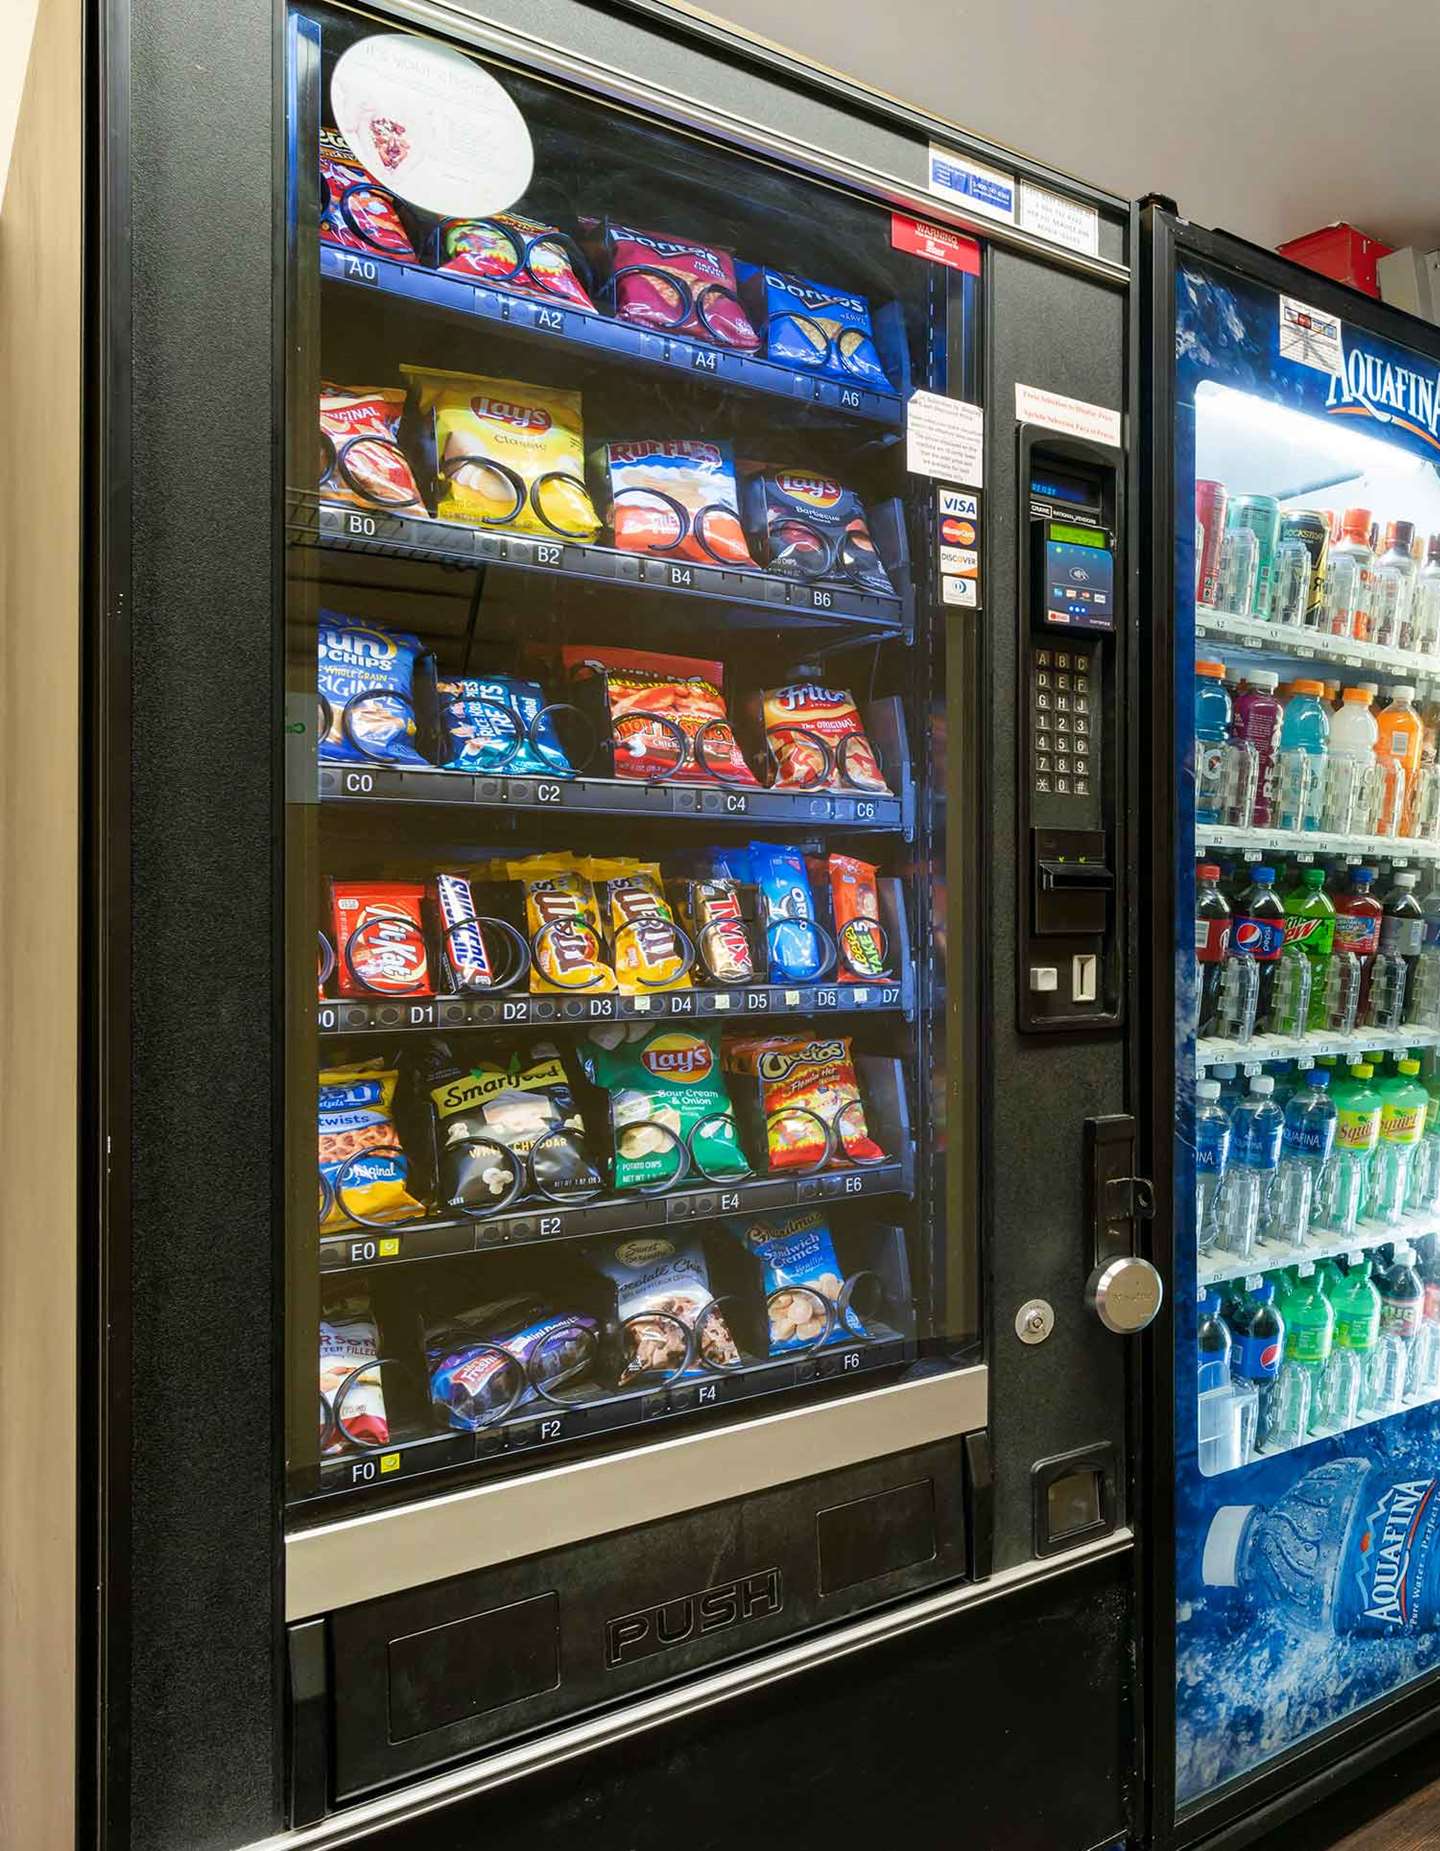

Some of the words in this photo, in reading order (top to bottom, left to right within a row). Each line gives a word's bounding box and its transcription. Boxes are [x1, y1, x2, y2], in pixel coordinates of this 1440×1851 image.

[610, 229, 720, 268] Doritos
[349, 262, 375, 279] A0
[765, 275, 863, 312] Doritos
[539, 311, 561, 329] A2
[695, 353, 716, 369] A4
[841, 391, 860, 407] A6
[480, 398, 547, 428] Lay's
[610, 440, 722, 468] RUFFLES
[782, 475, 838, 497] Lay's
[944, 497, 976, 514] VISA
[350, 516, 375, 535] B0
[538, 547, 560, 564] B2
[941, 553, 976, 566] DISCOVER
[672, 569, 691, 585] B4
[814, 592, 831, 607] B6
[328, 649, 392, 671] CHIPS
[1039, 675, 1046, 686] D
[1058, 697, 1066, 709] H
[1039, 716, 1045, 727] 1
[1058, 718, 1066, 730] 2
[1077, 720, 1084, 732] 3
[1039, 736, 1046, 747] 4
[1058, 738, 1066, 750] 5
[1077, 740, 1085, 751] 6
[1039, 757, 1046, 769] 7
[1058, 759, 1066, 771] 8
[1077, 760, 1085, 772] 9
[347, 774, 373, 792] C0
[538, 784, 560, 802] C2
[727, 796, 746, 811] C4
[857, 802, 874, 818] C6
[705, 892, 752, 968] TWIX
[368, 937, 418, 977] Kat
[672, 996, 691, 1012] D4
[748, 994, 767, 1009] D5
[818, 992, 836, 1006] D6
[883, 989, 899, 1003] D7
[411, 1006, 433, 1023] D1
[504, 1004, 527, 1020] D2
[591, 1000, 612, 1016] D3
[319, 1010, 334, 1028] 0
[650, 1048, 706, 1073] Lay's
[760, 1042, 843, 1079] Cheetos
[657, 1089, 684, 1098] Sour
[685, 1088, 718, 1099] Cream
[682, 1097, 712, 1105] Onion
[319, 1114, 369, 1126] twists
[1284, 1128, 1321, 1148] QUAFINA
[846, 1178, 862, 1192] E6
[722, 1194, 739, 1209] E4
[541, 1218, 561, 1235] E2
[352, 1243, 375, 1261] E0
[764, 1234, 820, 1260] Sandwich
[320, 1335, 376, 1347] RSON
[844, 1354, 860, 1369] F6
[700, 1386, 716, 1402] F4
[541, 1421, 561, 1439] F2
[352, 1462, 375, 1482] F0
[1421, 1506, 1439, 1549] Perfect
[1363, 1478, 1434, 1625] AQUAFINA
[1412, 1564, 1425, 1599] Water
[610, 1572, 779, 1663] PUSH
[1409, 1602, 1420, 1625] Pure
